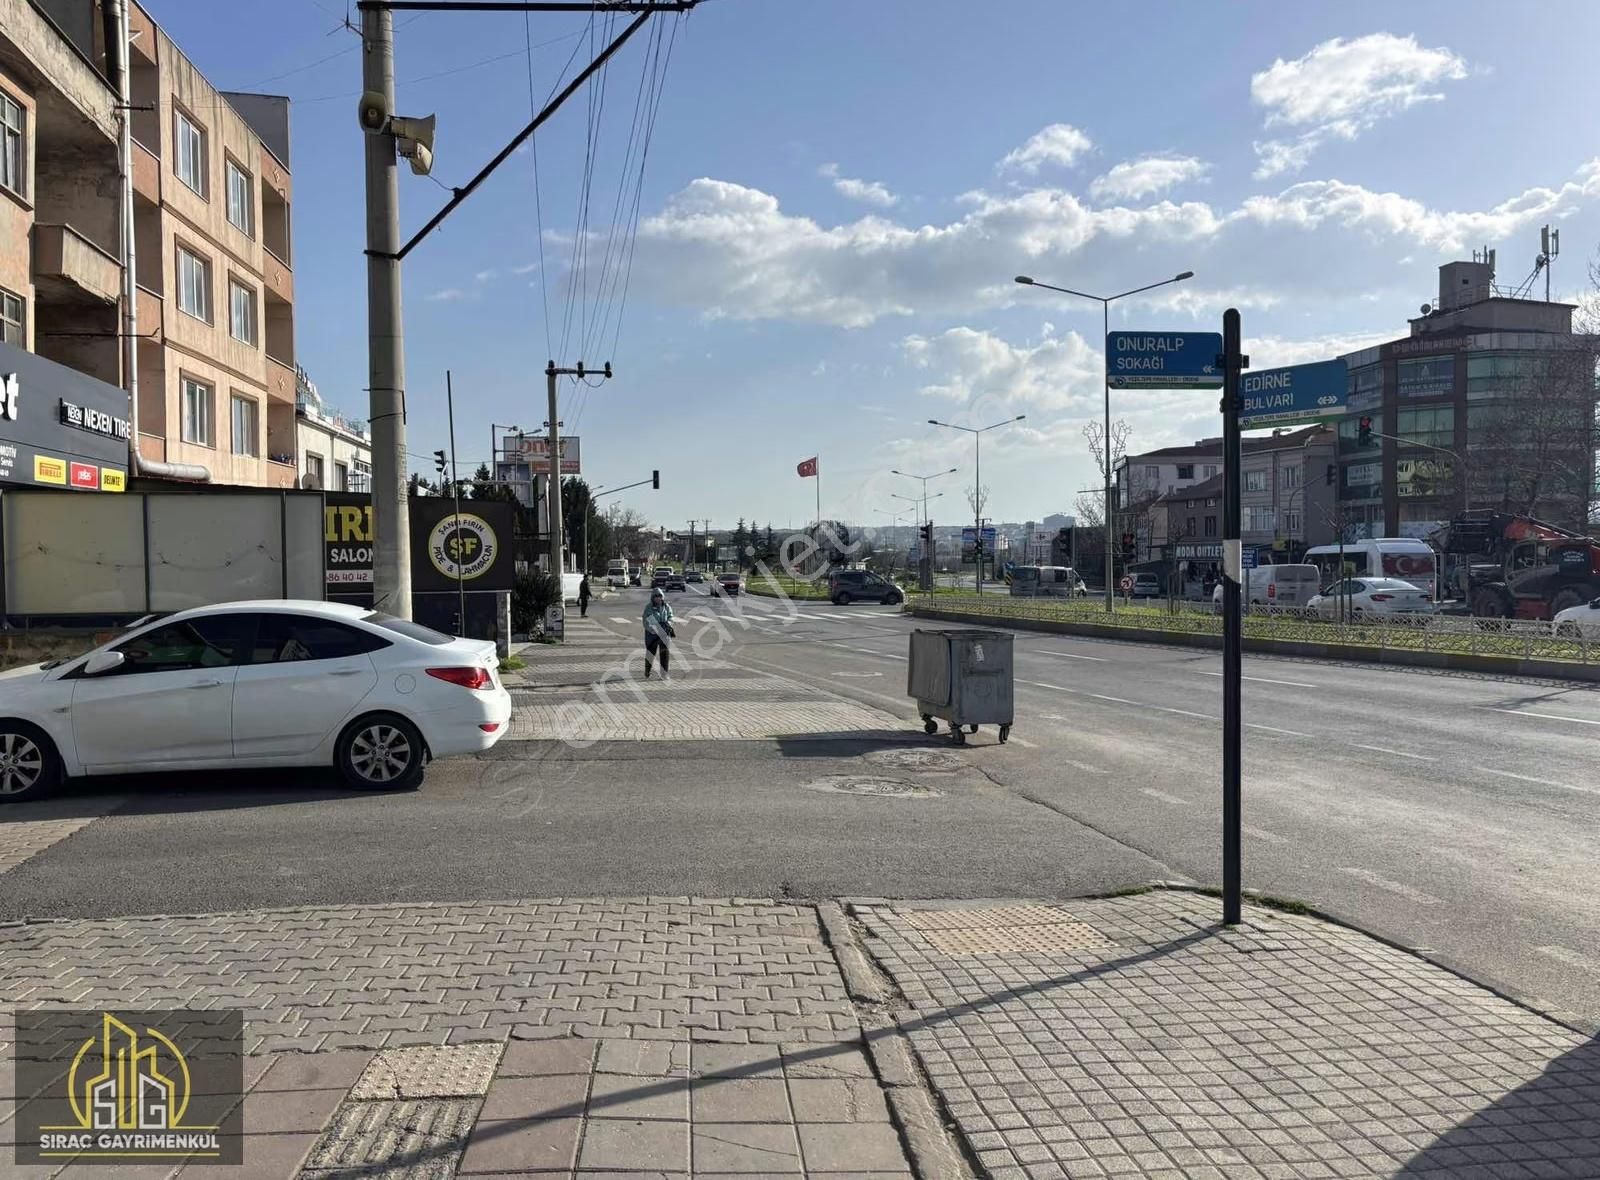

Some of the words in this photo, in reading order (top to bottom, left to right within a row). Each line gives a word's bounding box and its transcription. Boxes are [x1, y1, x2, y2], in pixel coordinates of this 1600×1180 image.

[1116, 336, 1185, 352] ONURALP
[1116, 356, 1164, 370] SOKAĞI
[1244, 371, 1292, 392] EDİRNE
[1244, 392, 1294, 411] BULVARI
[84, 407, 113, 434] NEXEN
[114, 418, 132, 439] TIRE
[342, 572, 354, 582] 40
[356, 572, 368, 582] 42
